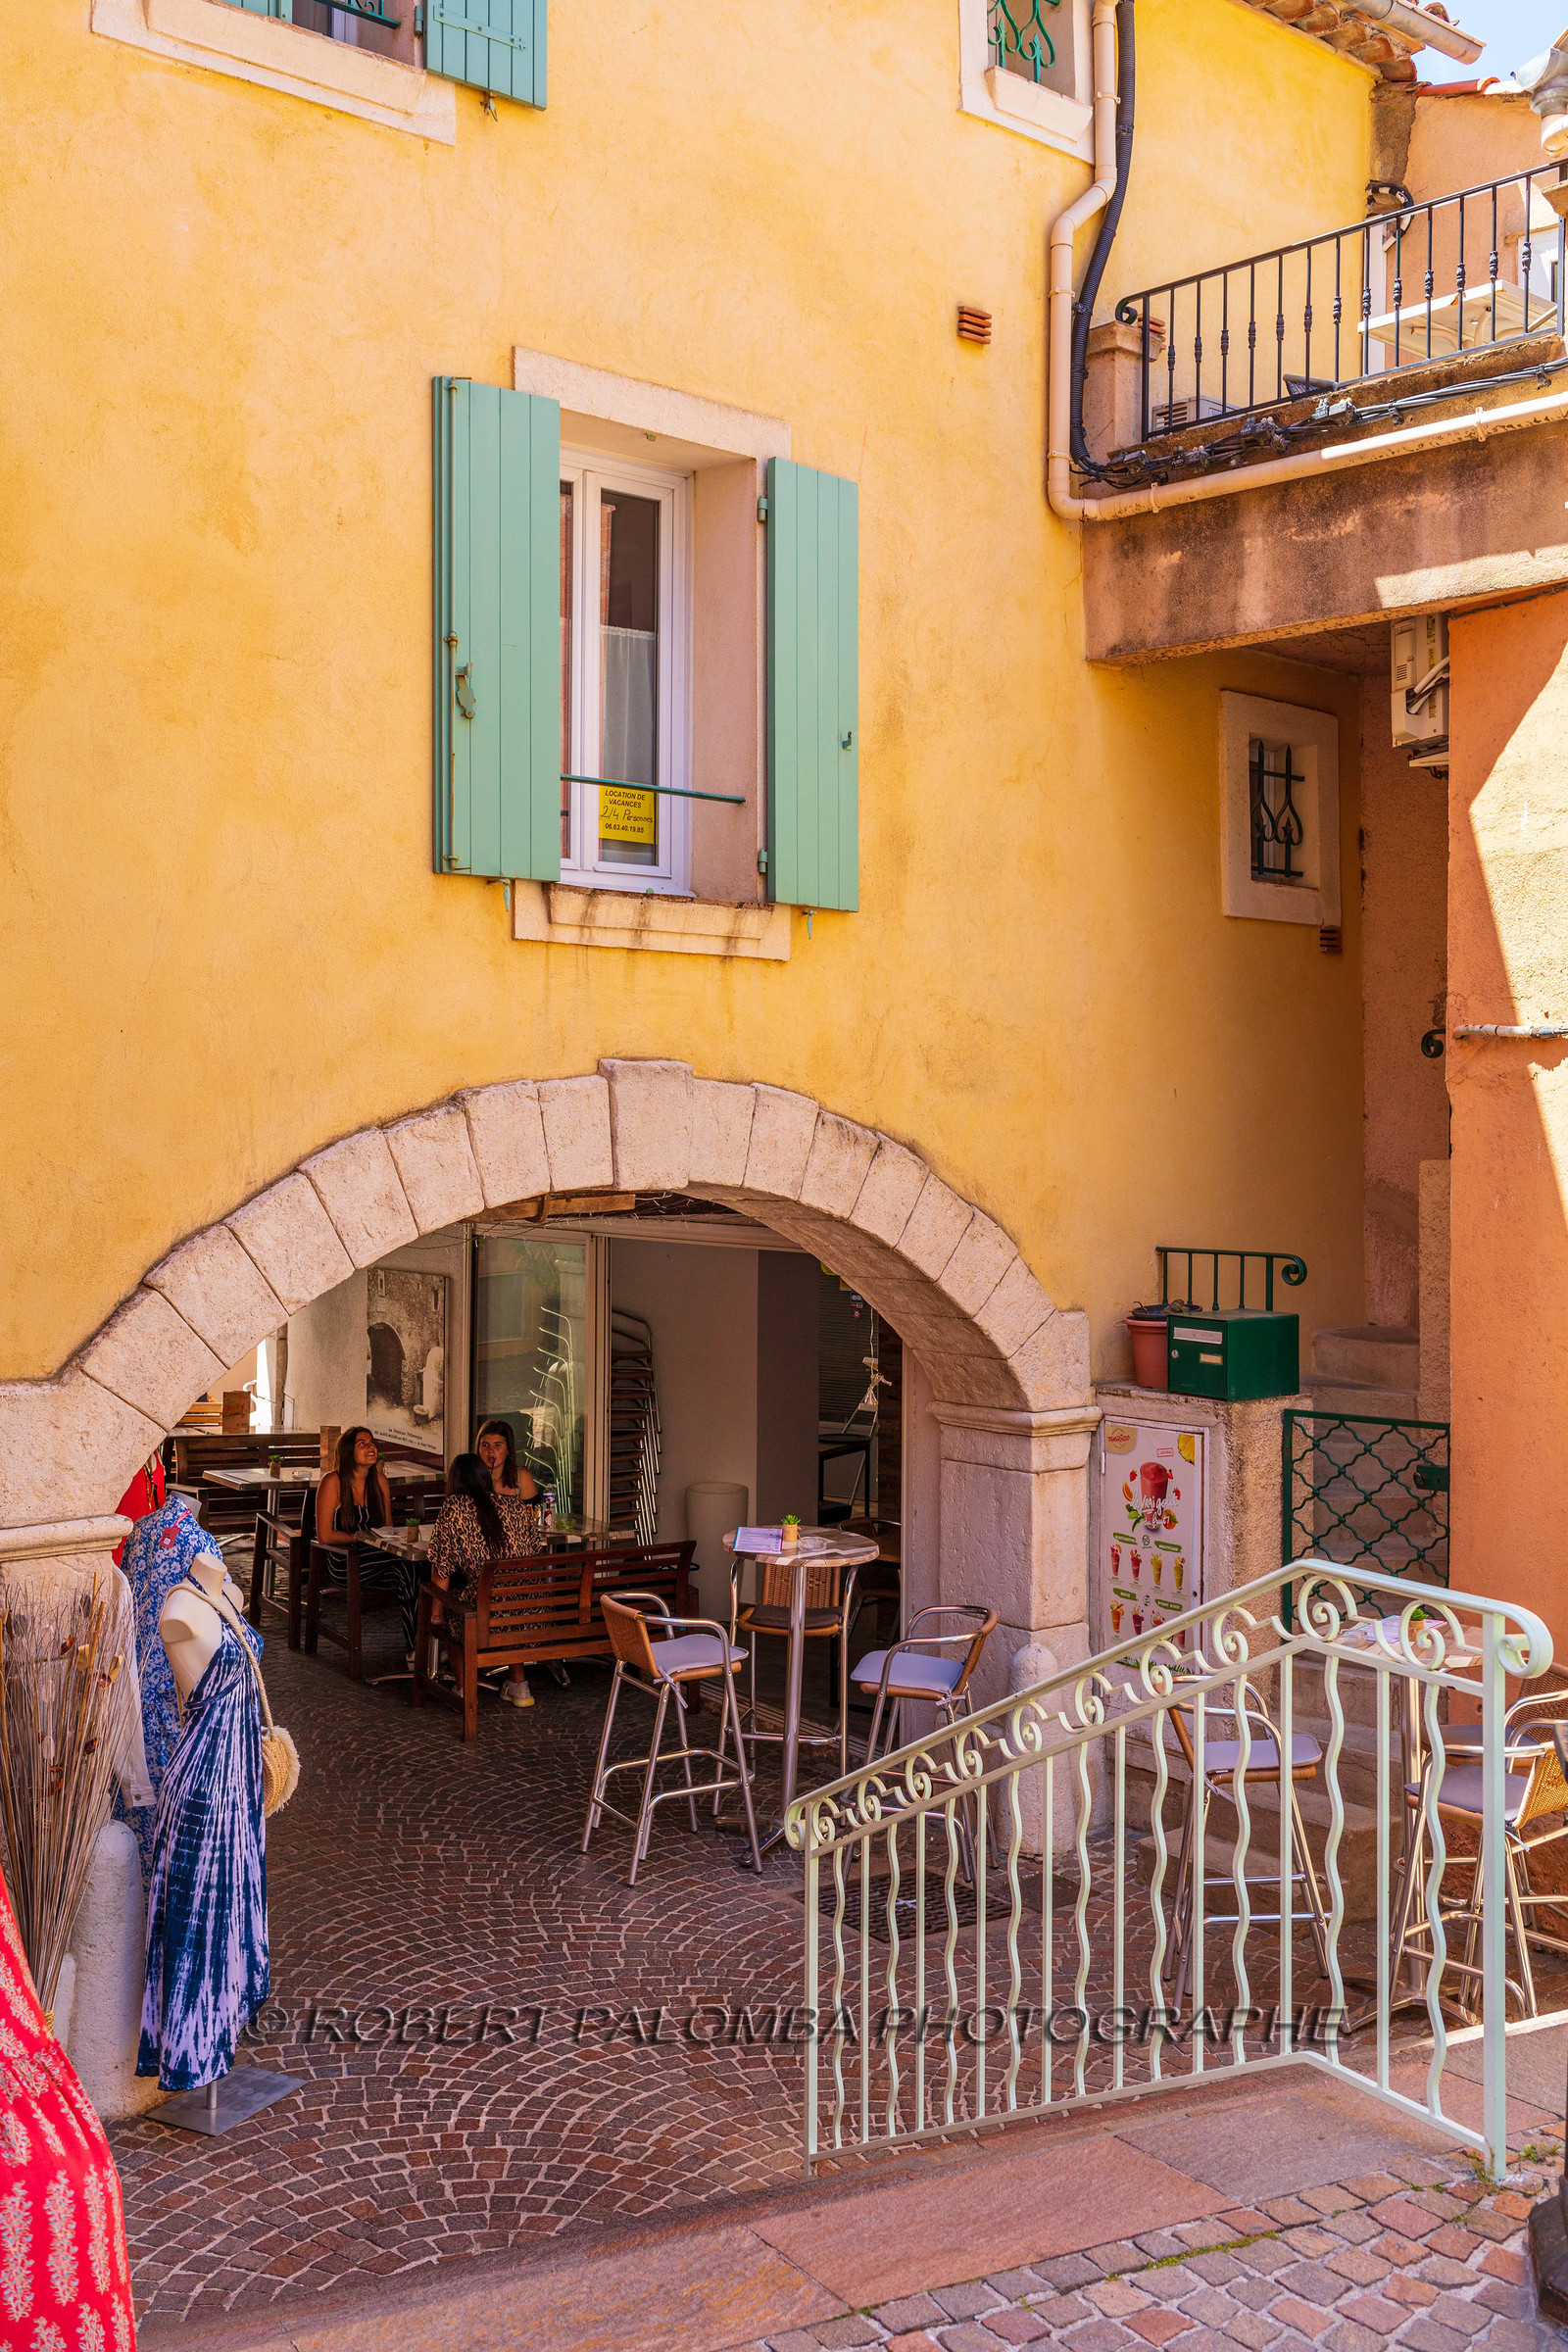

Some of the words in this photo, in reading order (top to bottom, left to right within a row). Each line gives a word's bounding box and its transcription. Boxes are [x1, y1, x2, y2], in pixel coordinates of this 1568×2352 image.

[605, 790, 636, 799] LOCATION
[609, 799, 642, 808] VACANCES
[601, 805, 619, 820] 2/4
[622, 808, 654, 823] Personnes
